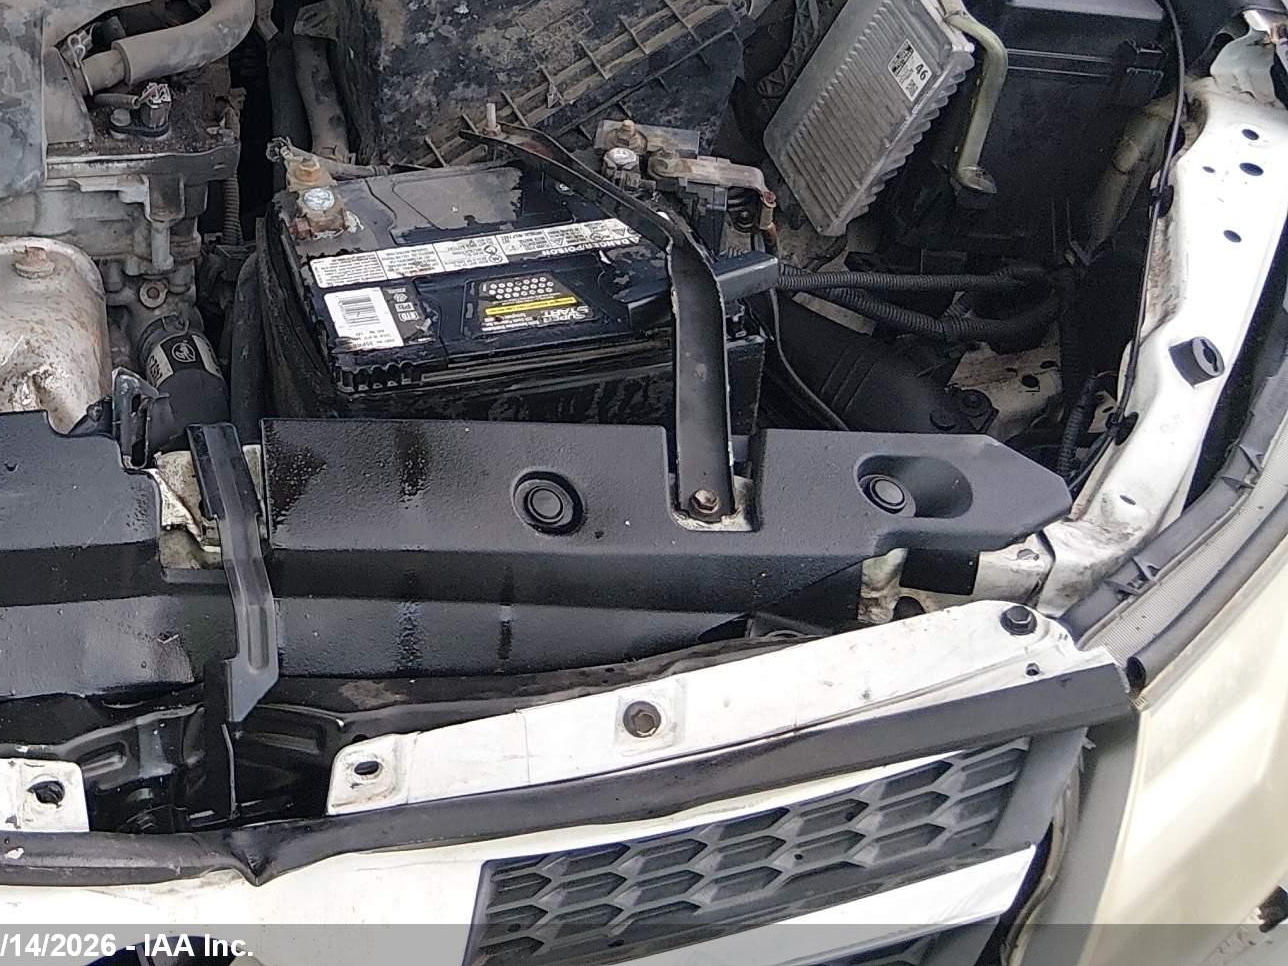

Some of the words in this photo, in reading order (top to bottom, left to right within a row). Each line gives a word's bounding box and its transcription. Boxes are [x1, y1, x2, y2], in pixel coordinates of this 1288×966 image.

[915, 63, 929, 81] 46
[542, 238, 631, 256] DANGER/POISON
[542, 313, 587, 324] SUPER
[543, 305, 589, 318] START
